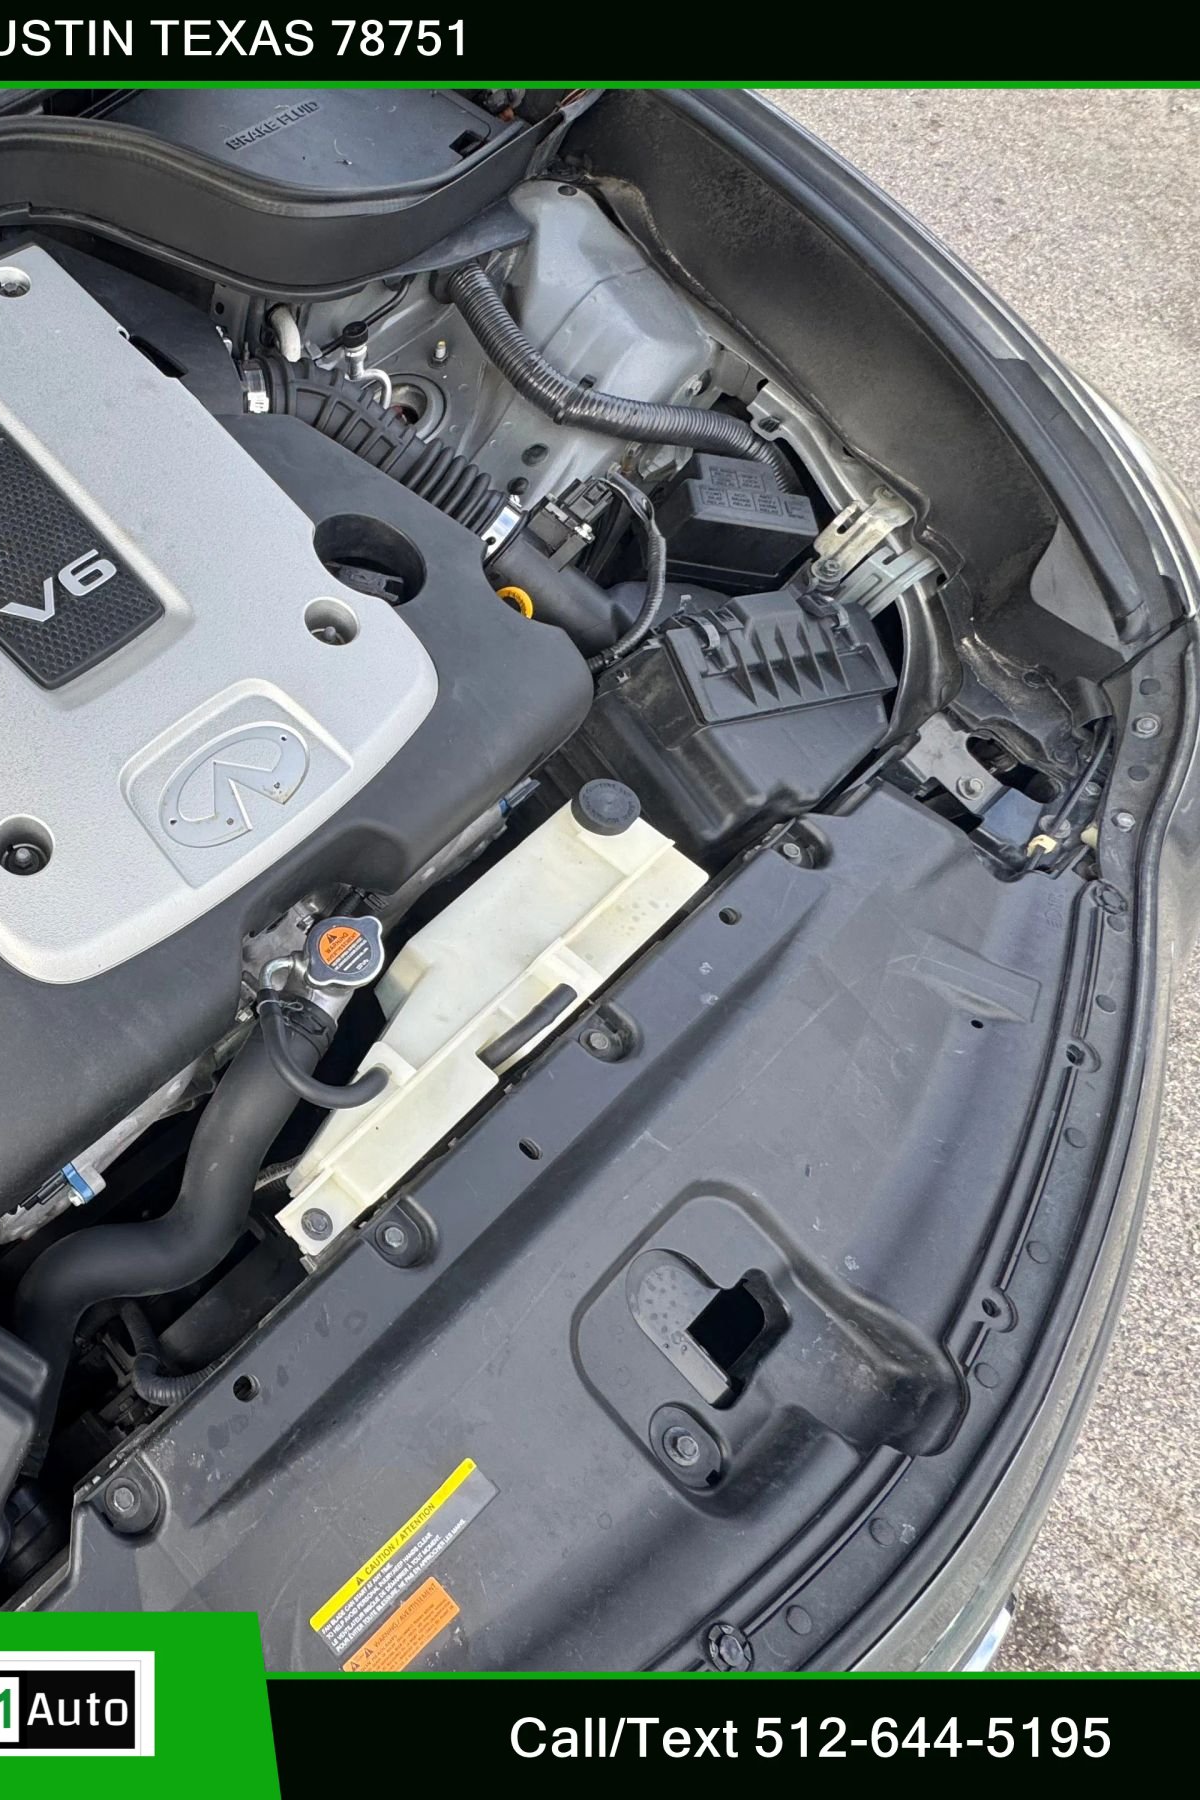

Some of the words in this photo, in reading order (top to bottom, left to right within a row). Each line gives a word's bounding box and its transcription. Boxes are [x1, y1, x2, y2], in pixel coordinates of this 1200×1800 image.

[225, 119, 280, 150] BRAKE
[276, 101, 319, 125] FLUID
[0, 549, 117, 622] V6
[363, 1543, 395, 1575] CAUTION
[398, 1502, 435, 1540] ATTENTION
[410, 1552, 423, 1566] TOUT
[332, 1619, 345, 1633] HELP
[342, 1606, 358, 1622] AVOID
[356, 1585, 379, 1609] PERSONAL
[401, 1545, 419, 1563] HANDS
[416, 1531, 433, 1548] CLEAR
[343, 1599, 355, 1611] CAN
[352, 1586, 368, 1602] START
